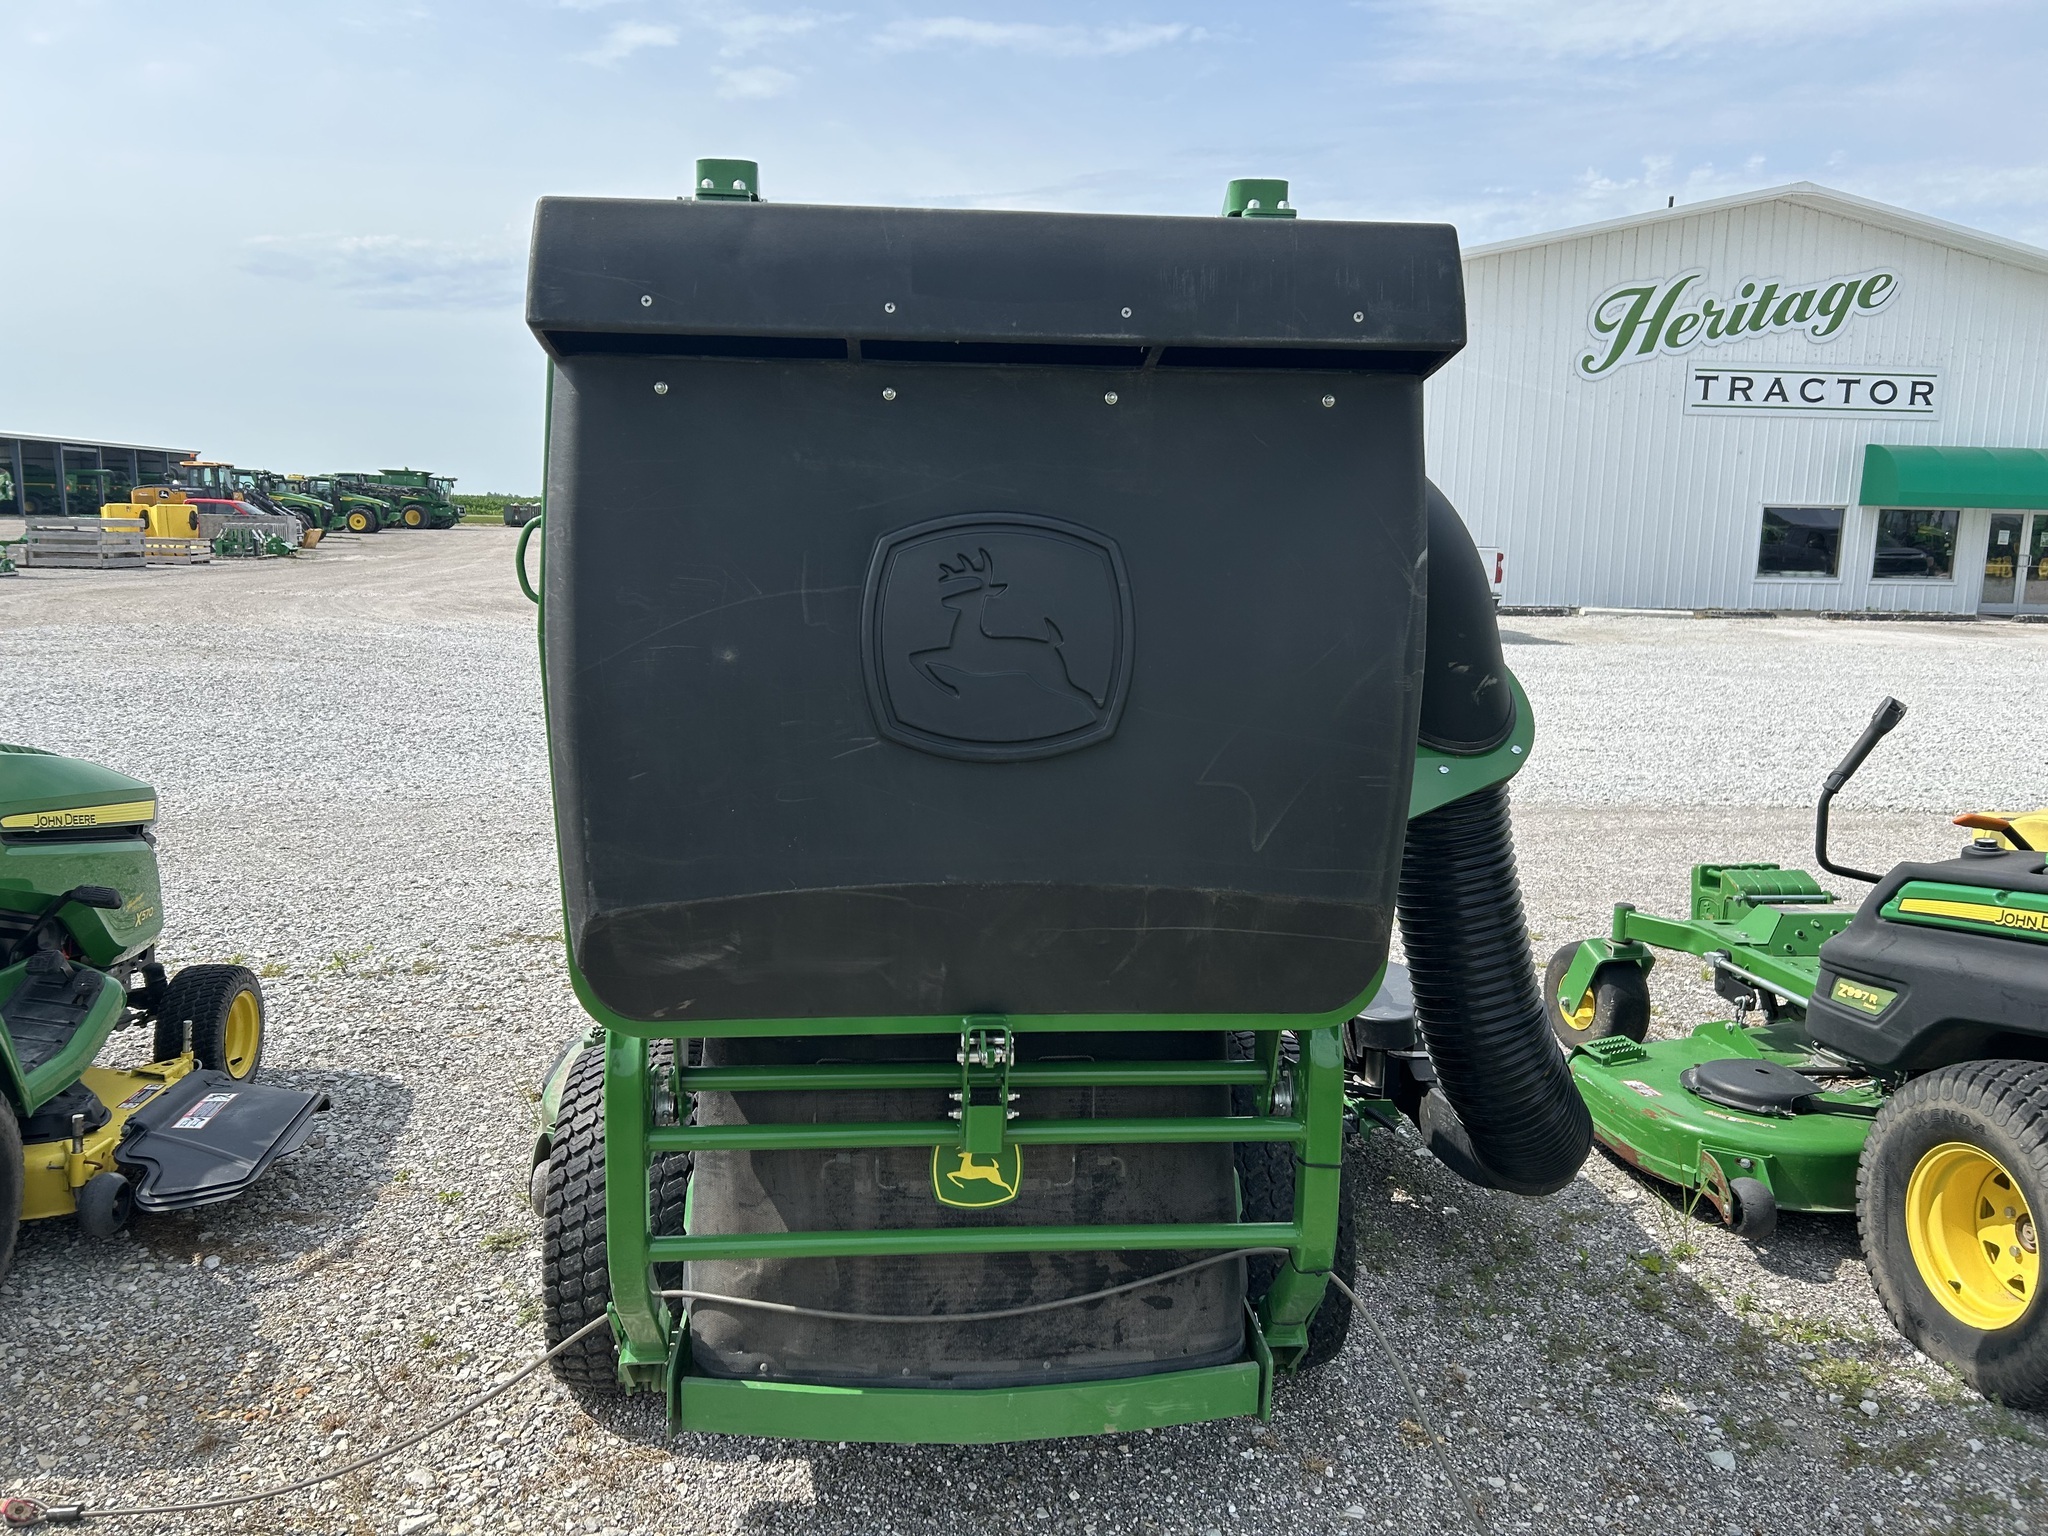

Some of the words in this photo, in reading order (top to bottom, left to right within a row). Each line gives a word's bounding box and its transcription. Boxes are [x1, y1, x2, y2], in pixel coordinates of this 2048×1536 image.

[1581, 273, 1900, 374] Heritage
[1694, 374, 1935, 407] TRACTOR
[34, 814, 63, 827] JOHN
[64, 813, 97, 826] DEERE
[134, 906, 154, 928] X570
[1994, 909, 2038, 928] JOHN
